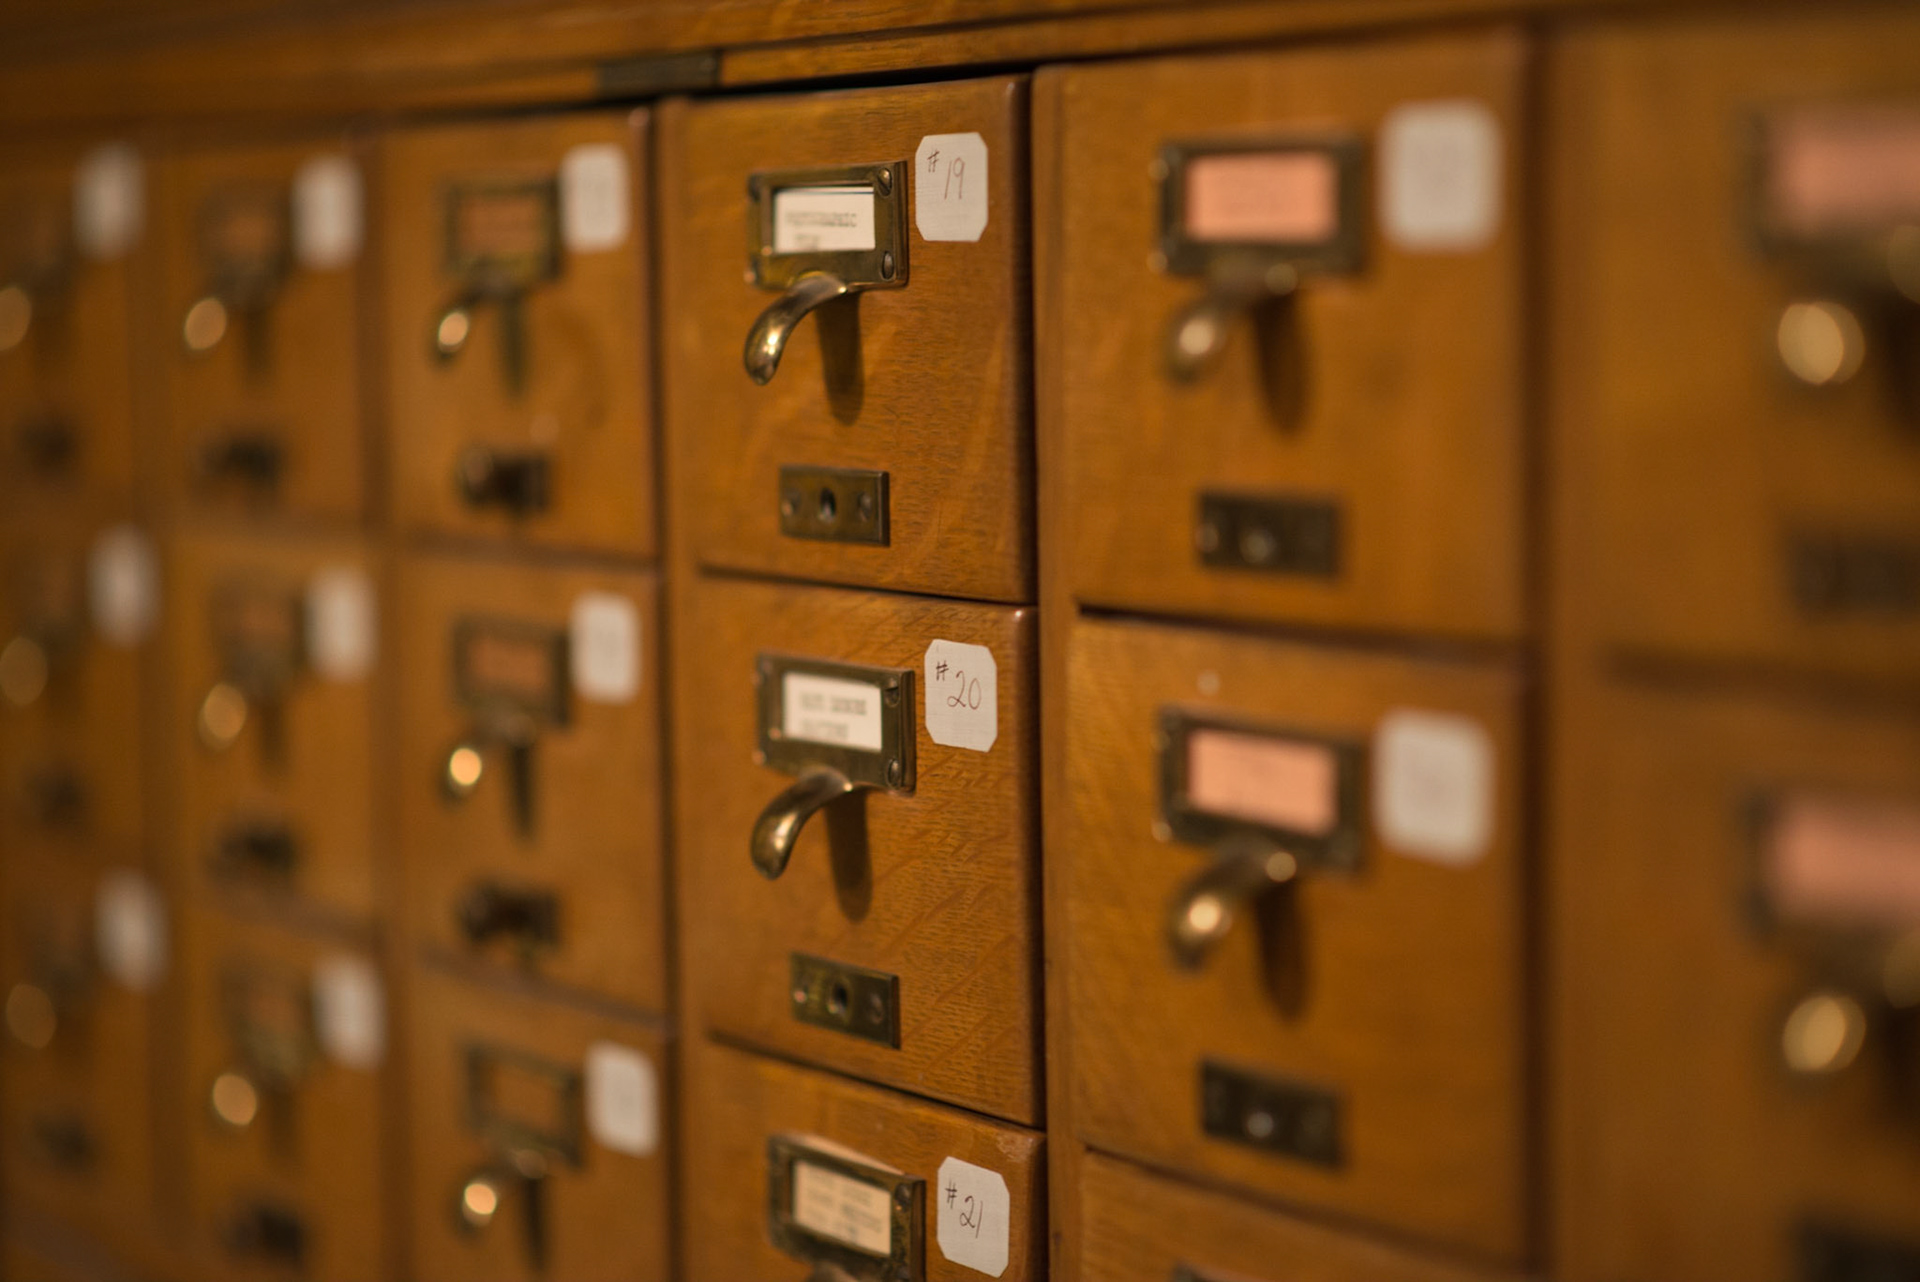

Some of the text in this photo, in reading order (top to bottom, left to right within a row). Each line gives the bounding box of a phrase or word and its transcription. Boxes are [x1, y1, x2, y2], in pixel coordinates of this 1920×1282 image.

[927, 149, 966, 200] #19
[935, 660, 982, 711] #20
[945, 1179, 983, 1239] #21
